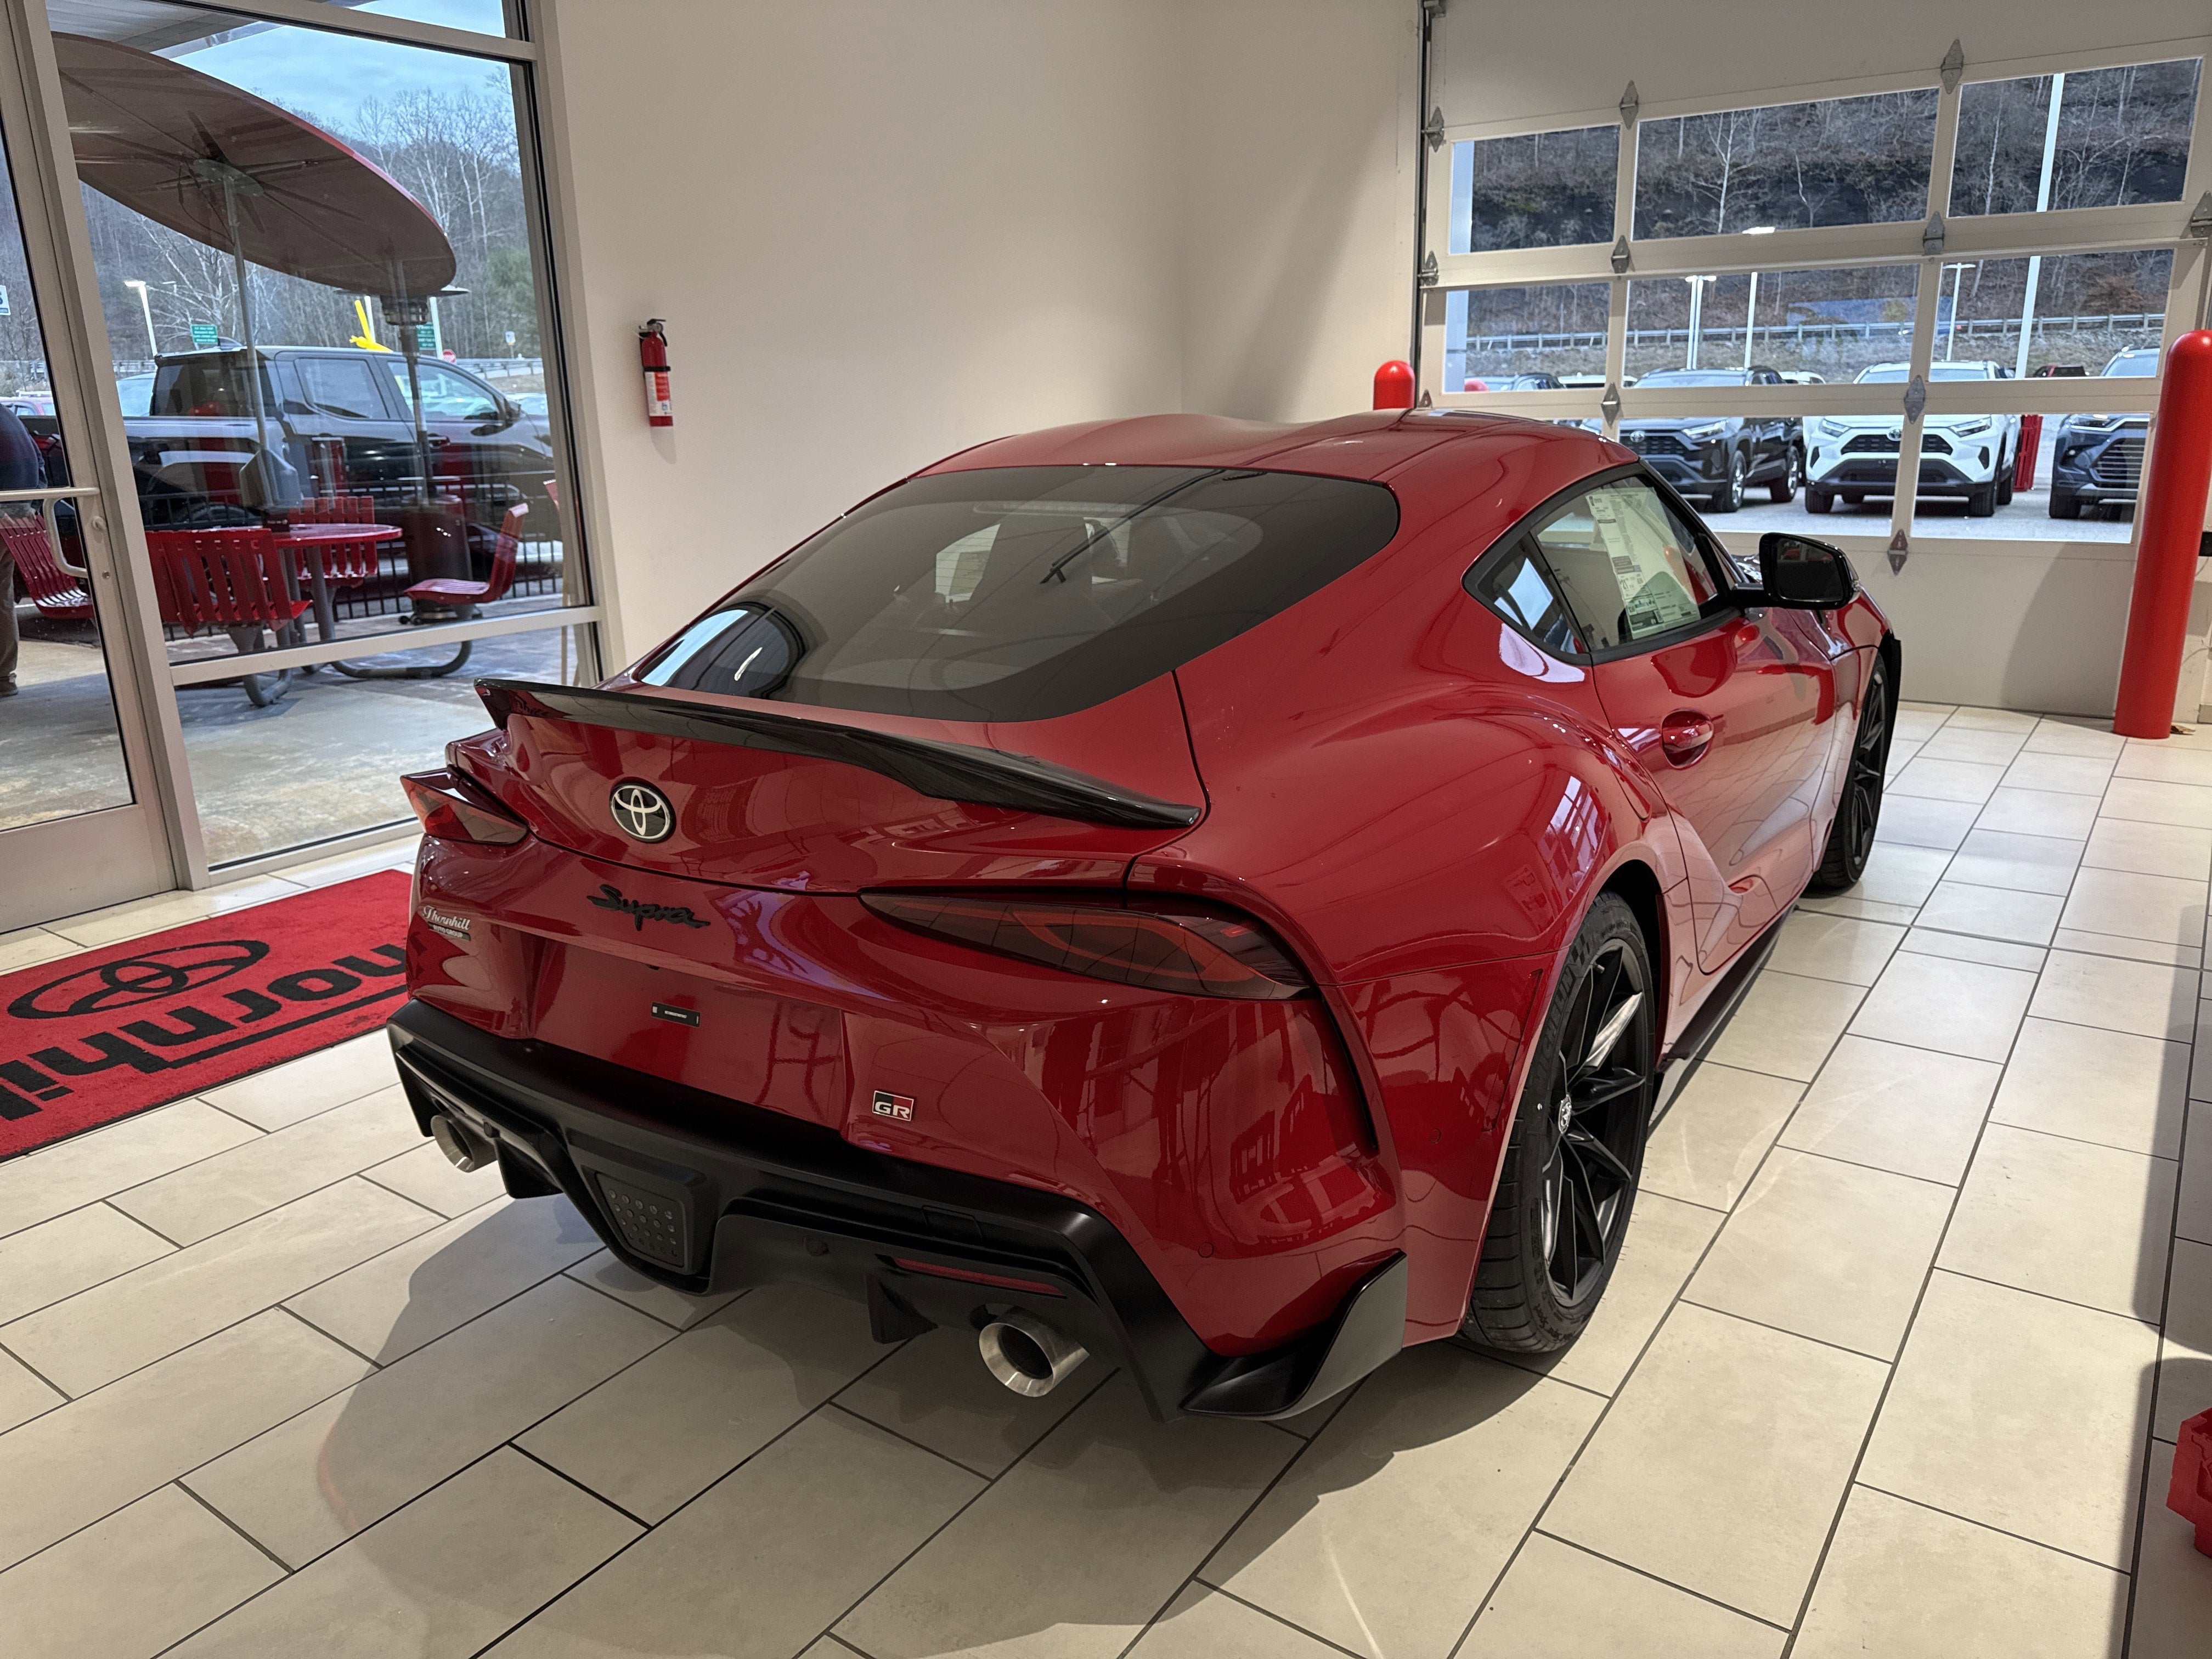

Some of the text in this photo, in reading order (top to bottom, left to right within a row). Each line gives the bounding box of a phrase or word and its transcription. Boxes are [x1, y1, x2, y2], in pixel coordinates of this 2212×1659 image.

[422, 905, 471, 930] Thornhill
[586, 884, 711, 932] Supra
[875, 1102, 910, 1119] GR
